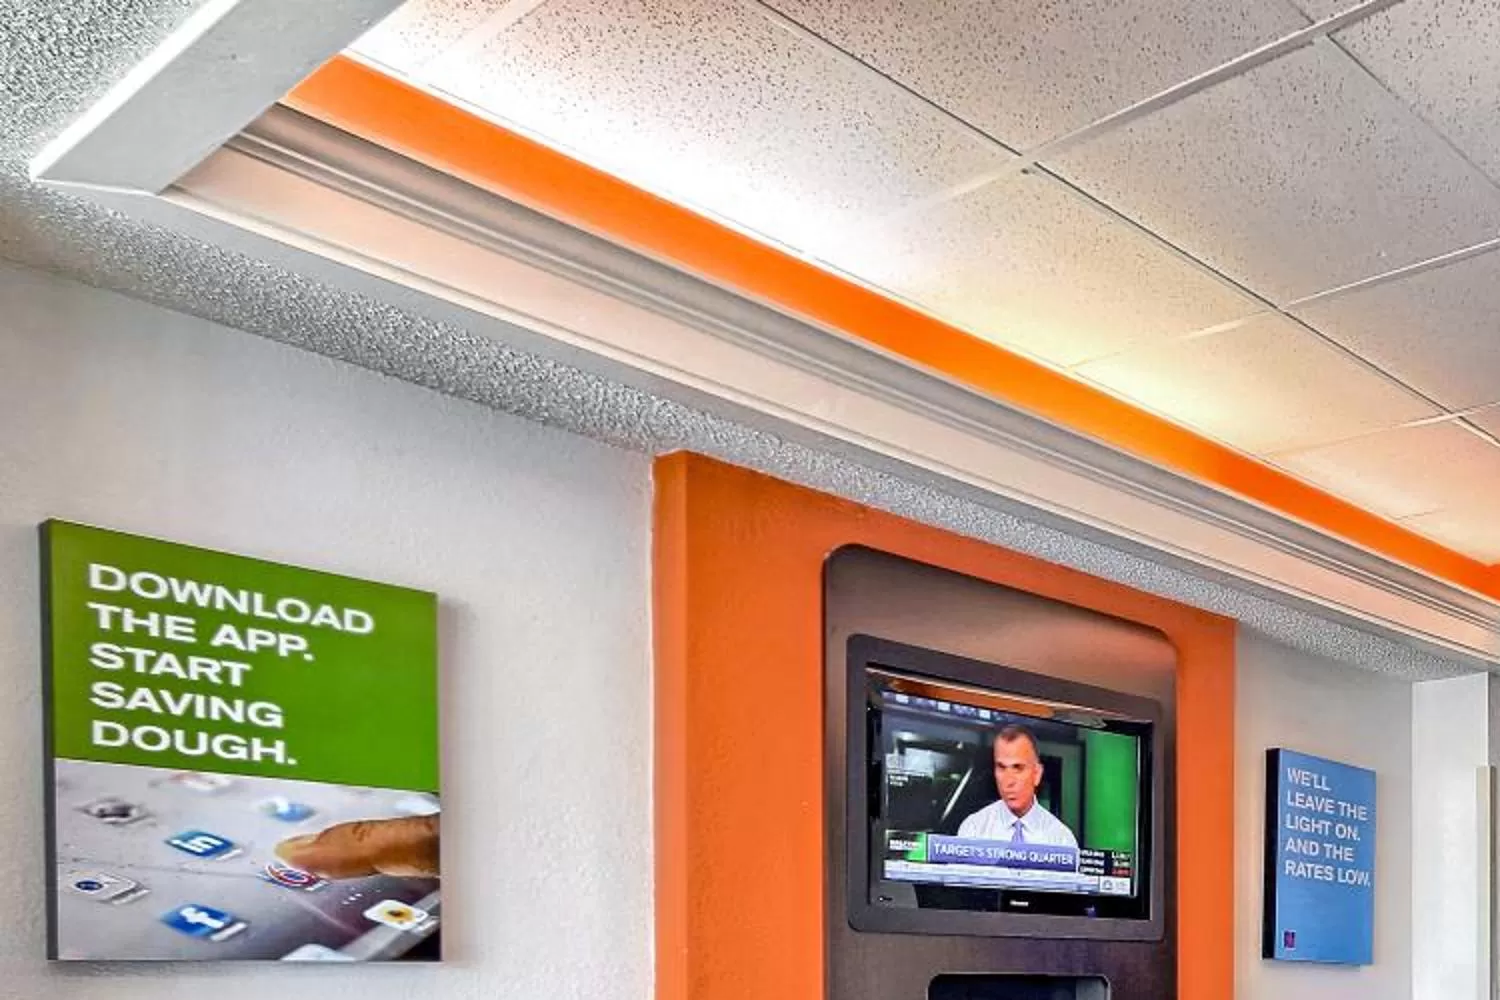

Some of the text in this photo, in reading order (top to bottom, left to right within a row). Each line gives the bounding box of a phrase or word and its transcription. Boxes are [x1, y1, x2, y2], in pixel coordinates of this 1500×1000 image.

[87, 563, 374, 634] DOWNLOAD
[87, 603, 316, 661] THE APP.
[89, 643, 251, 687] START
[90, 682, 284, 728] SAVING
[92, 720, 298, 765] DOUGH.
[1287, 767, 1331, 791] WE'LL
[1286, 791, 1368, 821] LEAVE THE
[1286, 814, 1333, 835] LIGHT
[987, 849, 1028, 861] STRONG
[1029, 851, 1074, 865] QUARTER
[1285, 837, 1355, 862] AND THE
[1285, 859, 1371, 888] RATES LOW.
